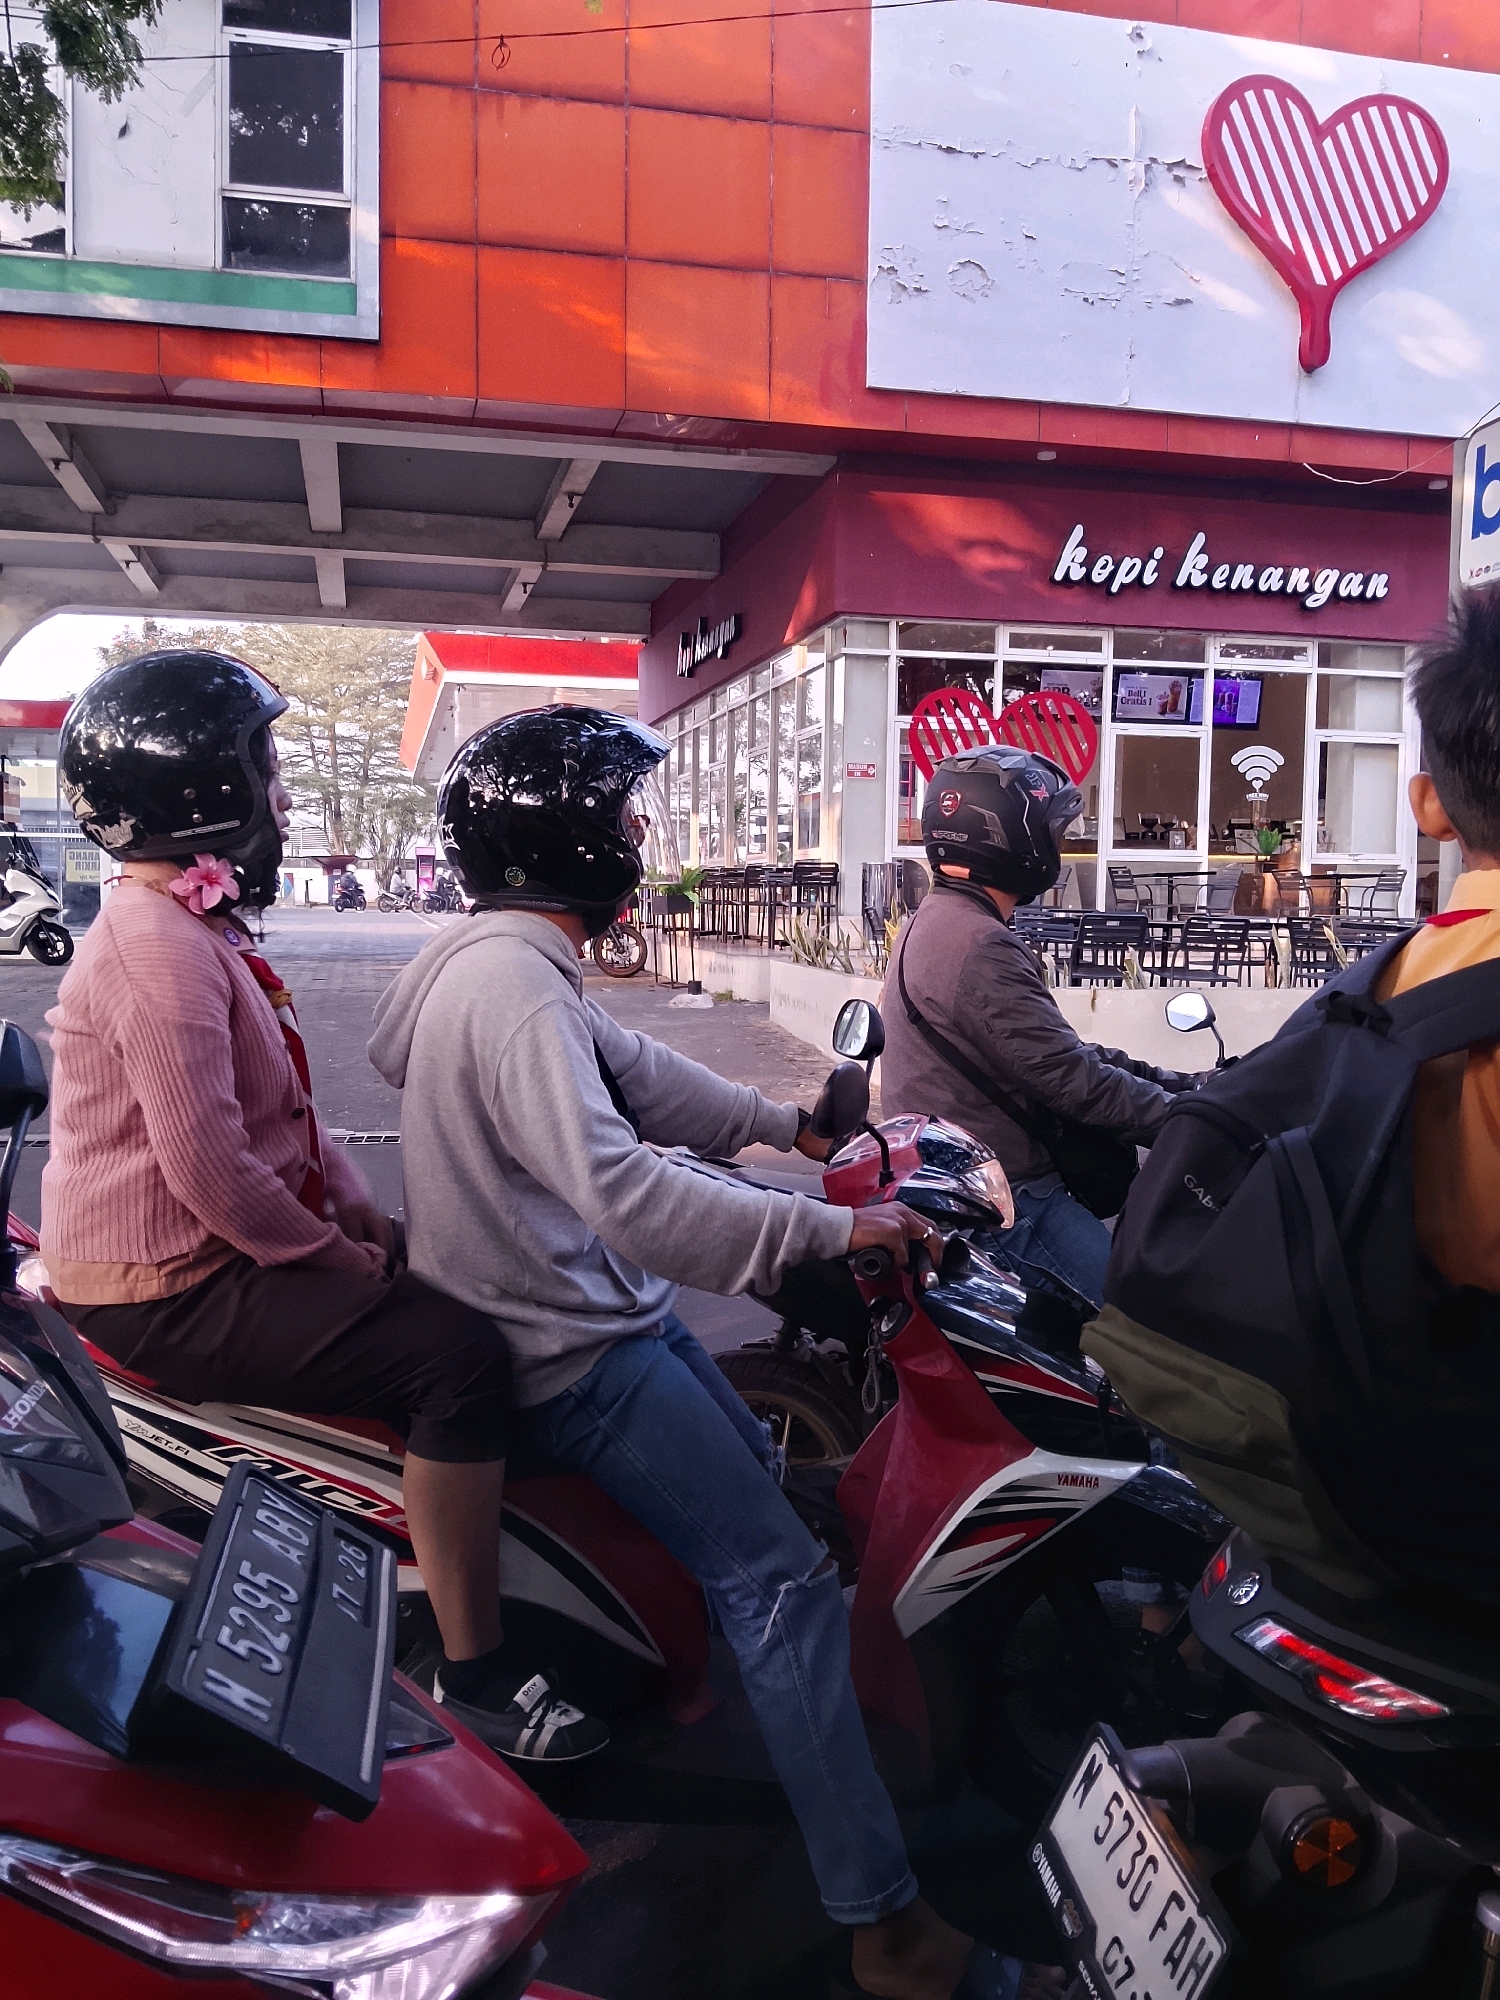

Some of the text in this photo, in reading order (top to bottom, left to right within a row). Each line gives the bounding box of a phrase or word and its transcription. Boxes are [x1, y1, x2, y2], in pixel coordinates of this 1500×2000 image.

[1053, 523, 1389, 608] kopi kenangan
[1025, 772, 1050, 802] JPX
[1057, 1474, 1099, 1488] YAMAHA
[203, 1489, 313, 1722] N 5295 ABY
[1037, 1853, 1062, 1908] YAMAHA
[1072, 1753, 1104, 1810] N
[1148, 1890, 1214, 2000] FAH
